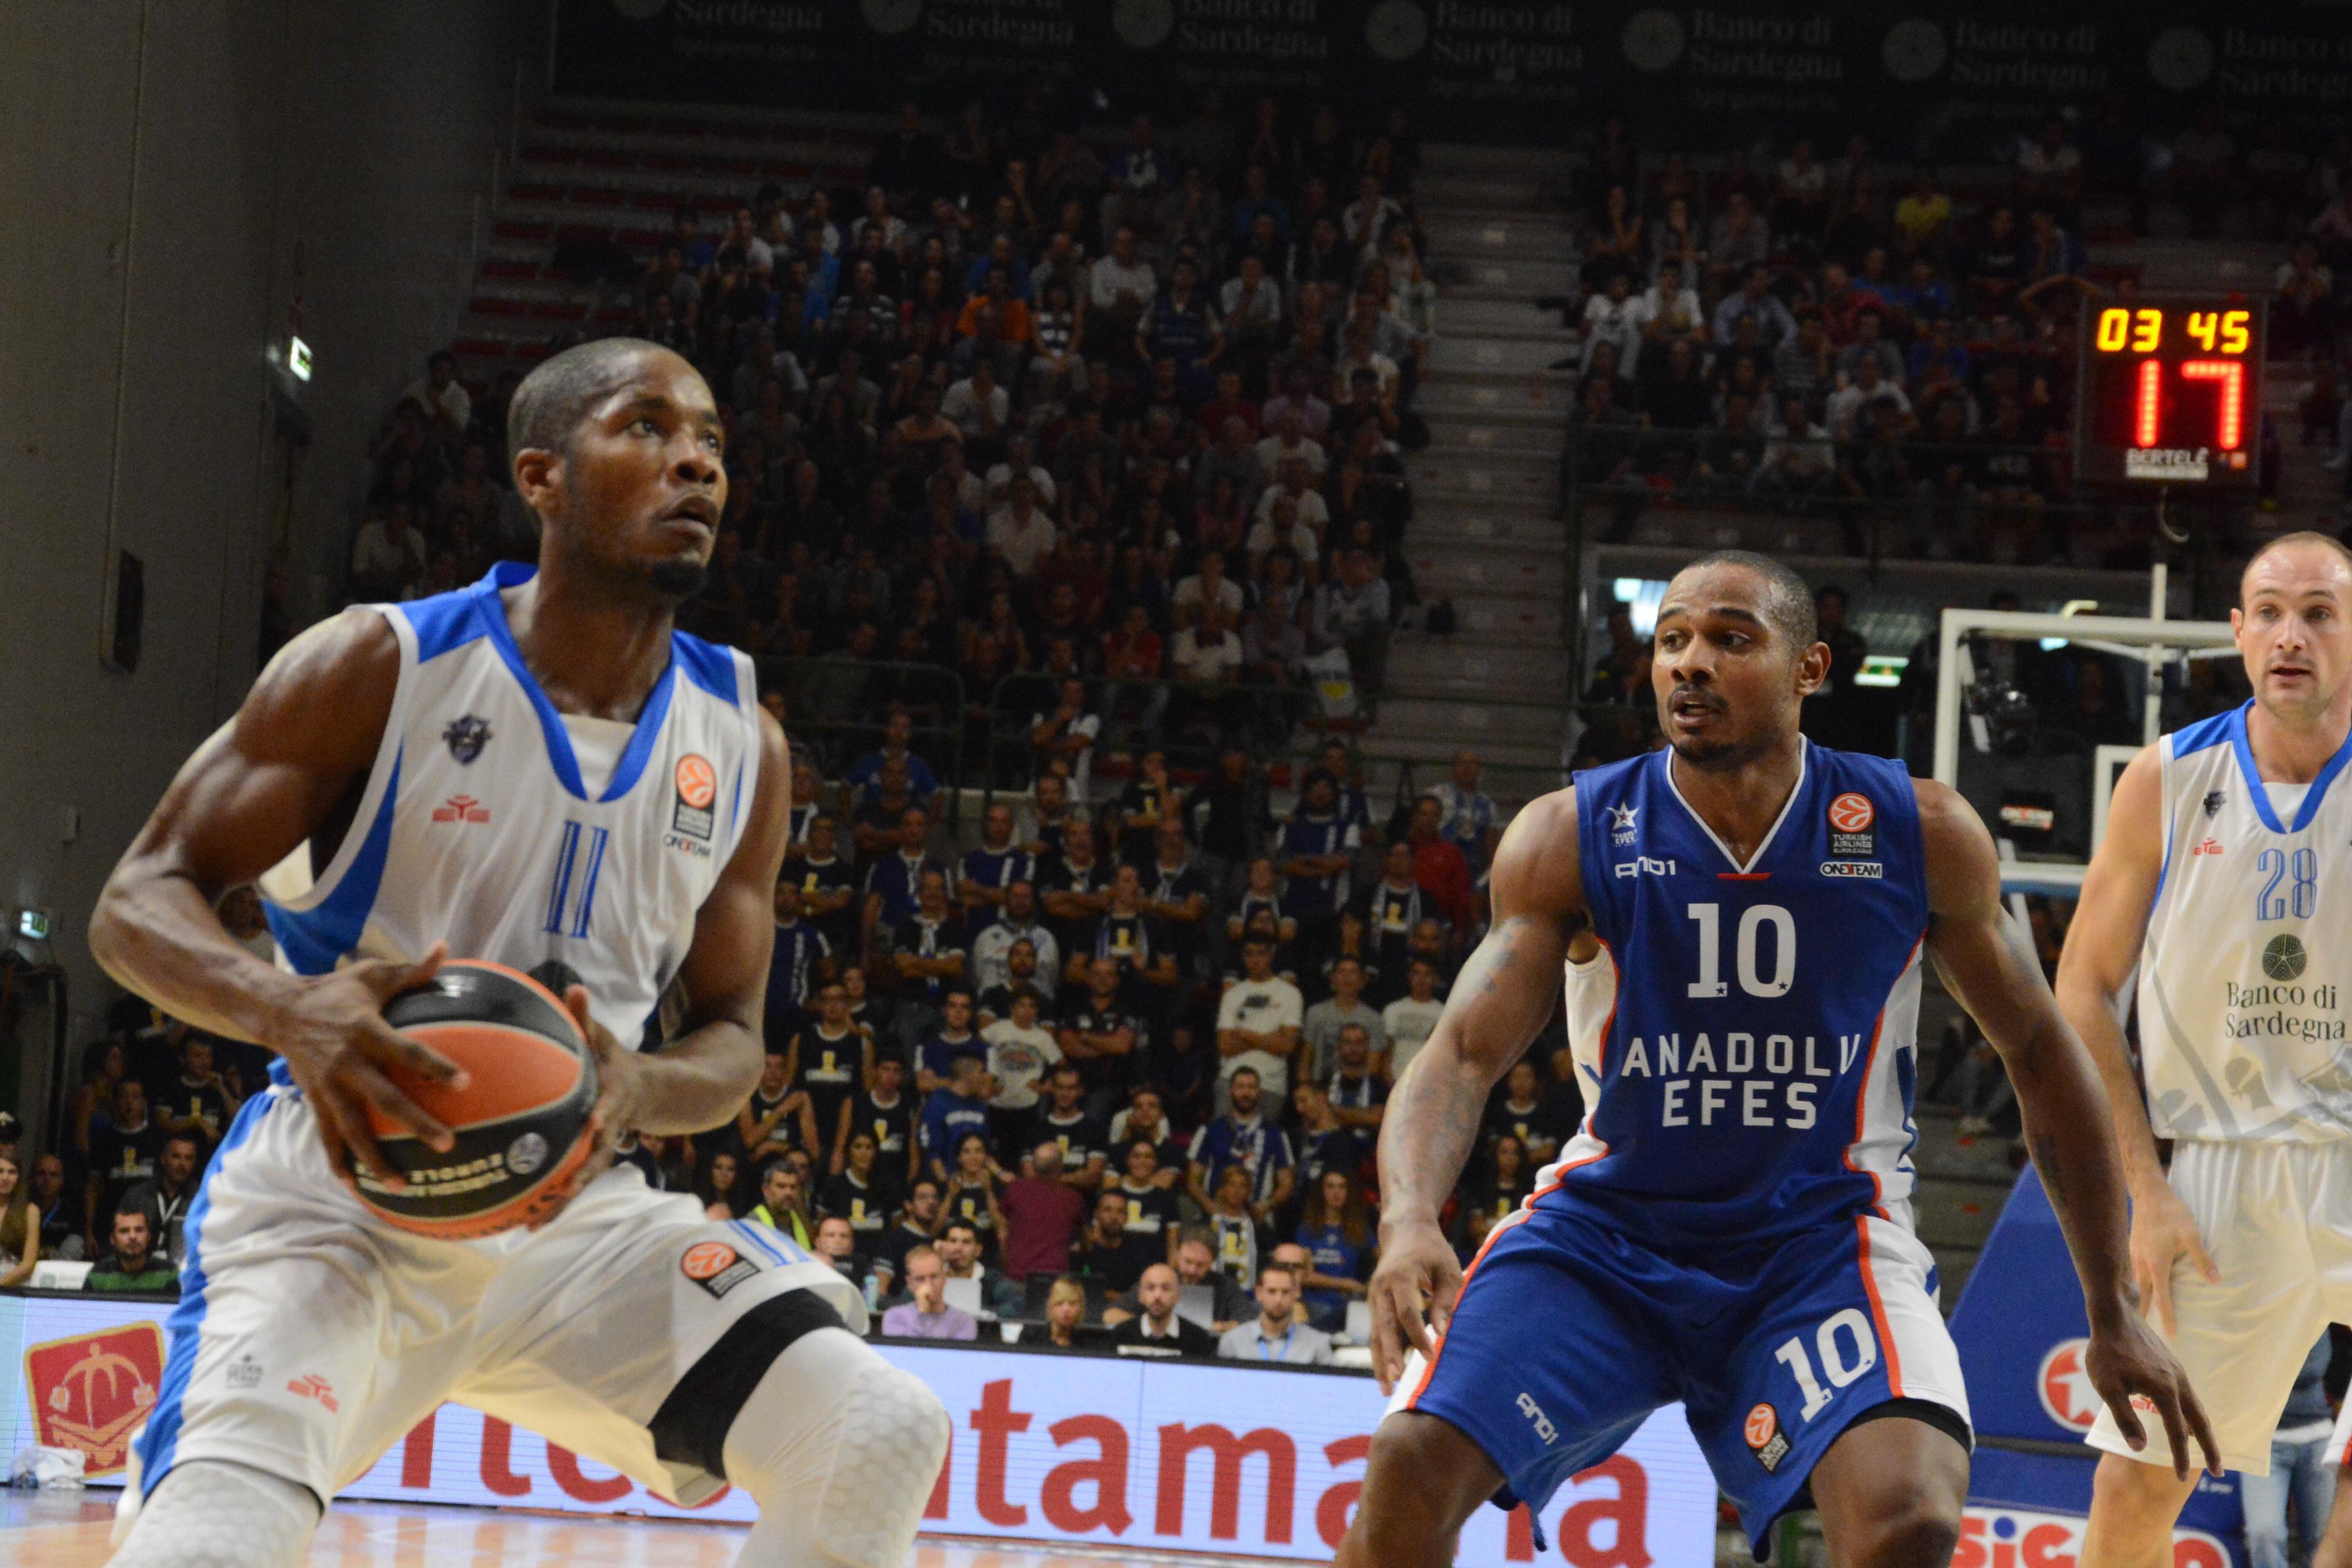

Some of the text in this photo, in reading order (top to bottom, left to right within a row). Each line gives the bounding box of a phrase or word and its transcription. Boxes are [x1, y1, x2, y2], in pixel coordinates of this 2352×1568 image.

[927, 9, 1074, 47] Sardegna
[1437, 0, 1572, 34] Banco di
[1692, 9, 1831, 43] Banco di
[1178, 22, 1328, 59] Sardegna
[1433, 34, 1583, 73] Sardegna
[2220, 61, 2352, 102] Sardeg
[2097, 308, 2250, 354] 03 45
[2136, 359, 2244, 450] 17
[544, 819, 608, 939] 11
[2256, 848, 2318, 921] 28
[1687, 903, 1796, 998] 10
[2226, 981, 2338, 1010] Banco di
[2225, 1011, 2346, 1044] Sardegna
[1662, 1079, 1818, 1130] EFES
[1775, 1308, 1877, 1423] 10
